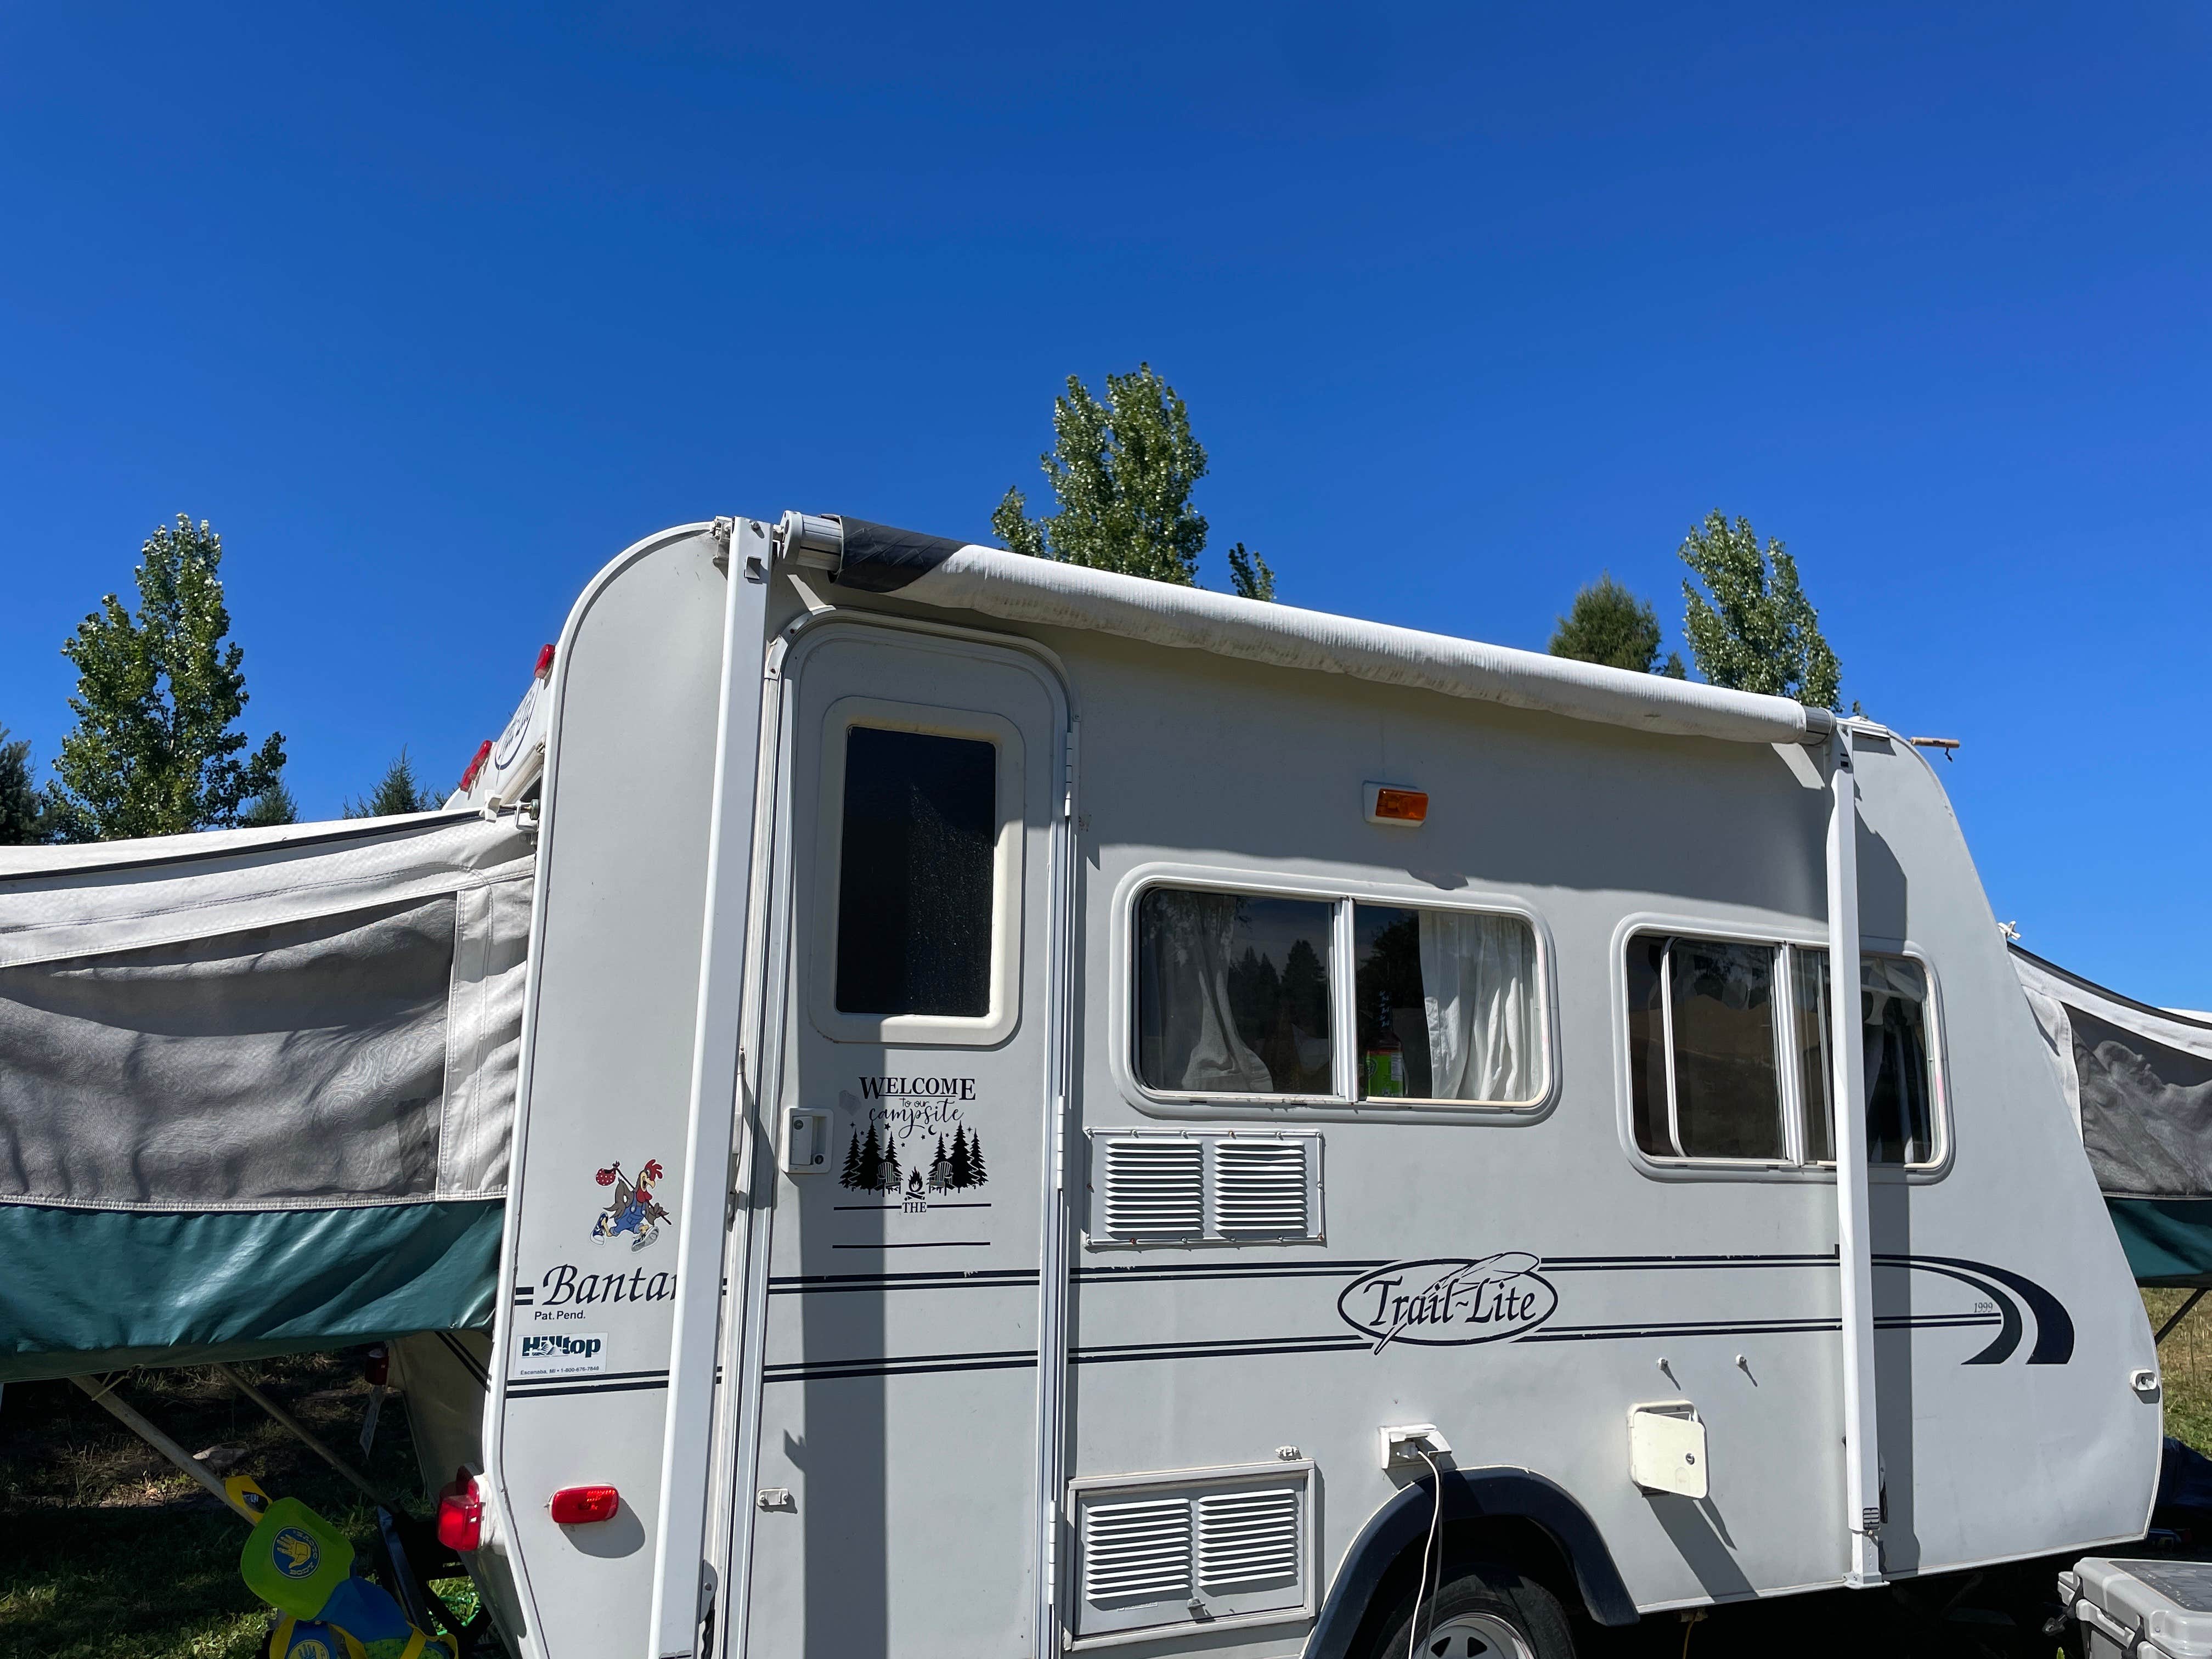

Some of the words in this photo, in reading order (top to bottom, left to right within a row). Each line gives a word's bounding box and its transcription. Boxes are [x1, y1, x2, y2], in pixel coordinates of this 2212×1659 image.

[859, 1076, 976, 1101] WELCOME
[899, 1097, 911, 1108] to
[868, 1098, 964, 1139] campsite
[902, 1201, 927, 1214] THE
[541, 1263, 677, 1306] Banta
[1363, 1275, 1536, 1327] Trail-Lite
[1973, 1302, 1994, 1313] 1999
[534, 1311, 555, 1321] Pat.
[556, 1310, 586, 1320] Pend.
[522, 1335, 601, 1358] Hilltop
